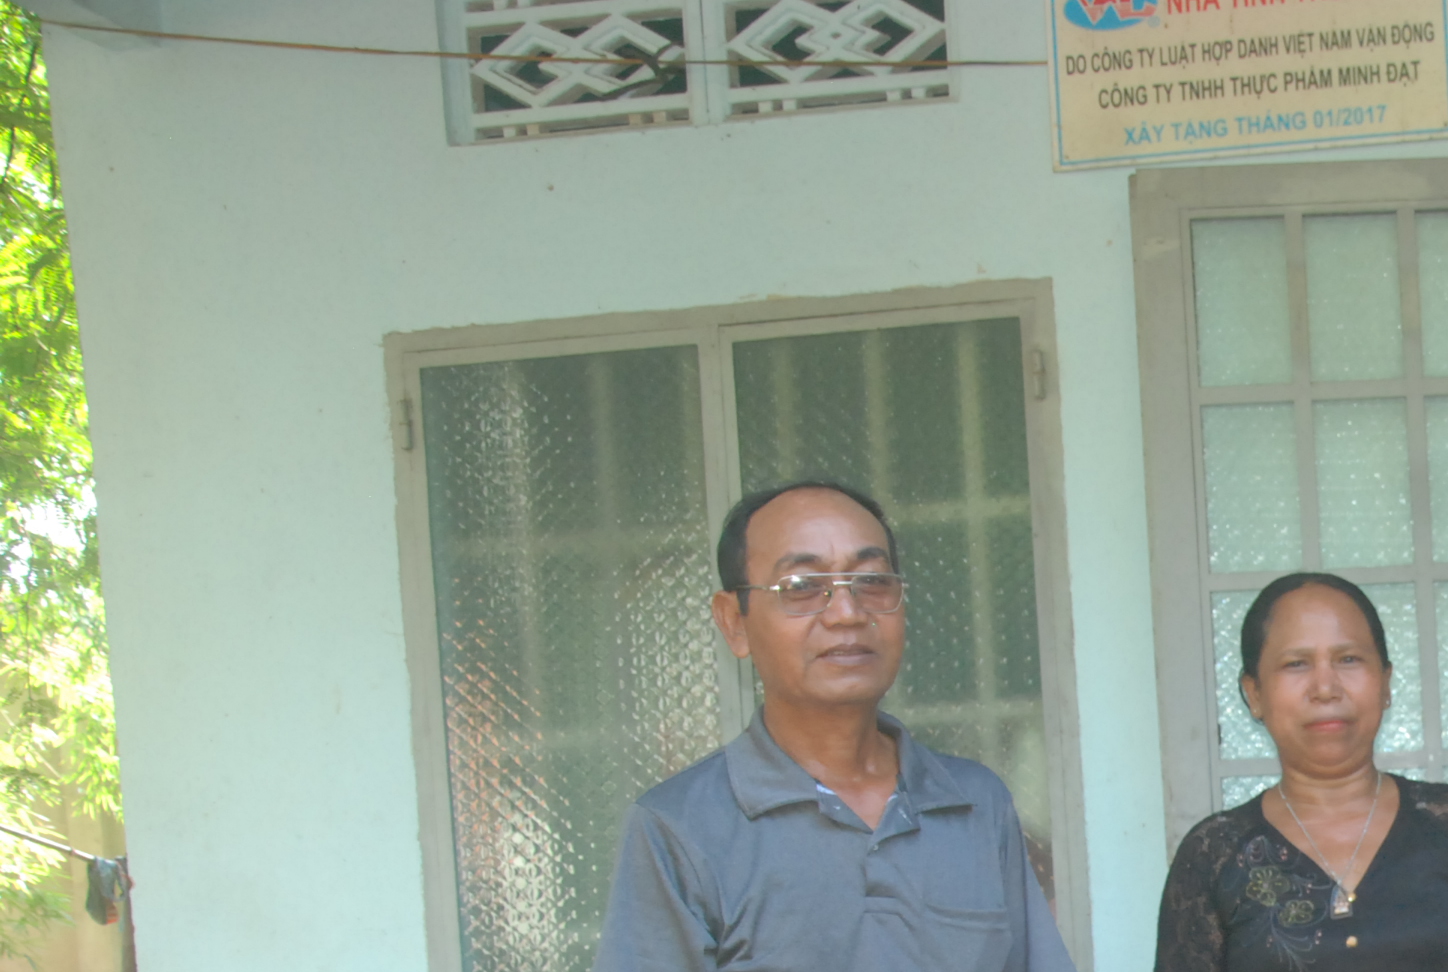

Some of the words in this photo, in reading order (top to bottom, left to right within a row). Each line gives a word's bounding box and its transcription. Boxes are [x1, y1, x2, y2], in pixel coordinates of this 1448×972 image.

[1066, 54, 1087, 75] DO
[1091, 47, 1133, 73] CÔNG
[1137, 47, 1154, 68] TY
[1159, 41, 1197, 69] LUẬT
[1202, 40, 1233, 66] HỢP
[1237, 36, 1279, 59] DANH
[1283, 30, 1314, 59] VIỆT
[1319, 29, 1353, 52] NAM
[1391, 20, 1435, 50] ĐỘNG
[1098, 83, 1148, 109] CÔNG
[1153, 84, 1173, 104] TY
[1179, 79, 1225, 102] TNHH
[1229, 73, 1278, 99] THỰC
[1338, 65, 1381, 87] MINH
[1386, 60, 1421, 87] ĐẠT
[1124, 121, 1165, 146] XÂY
[1234, 109, 1307, 135] THÁNG
[1313, 104, 1388, 129] 01/2017
